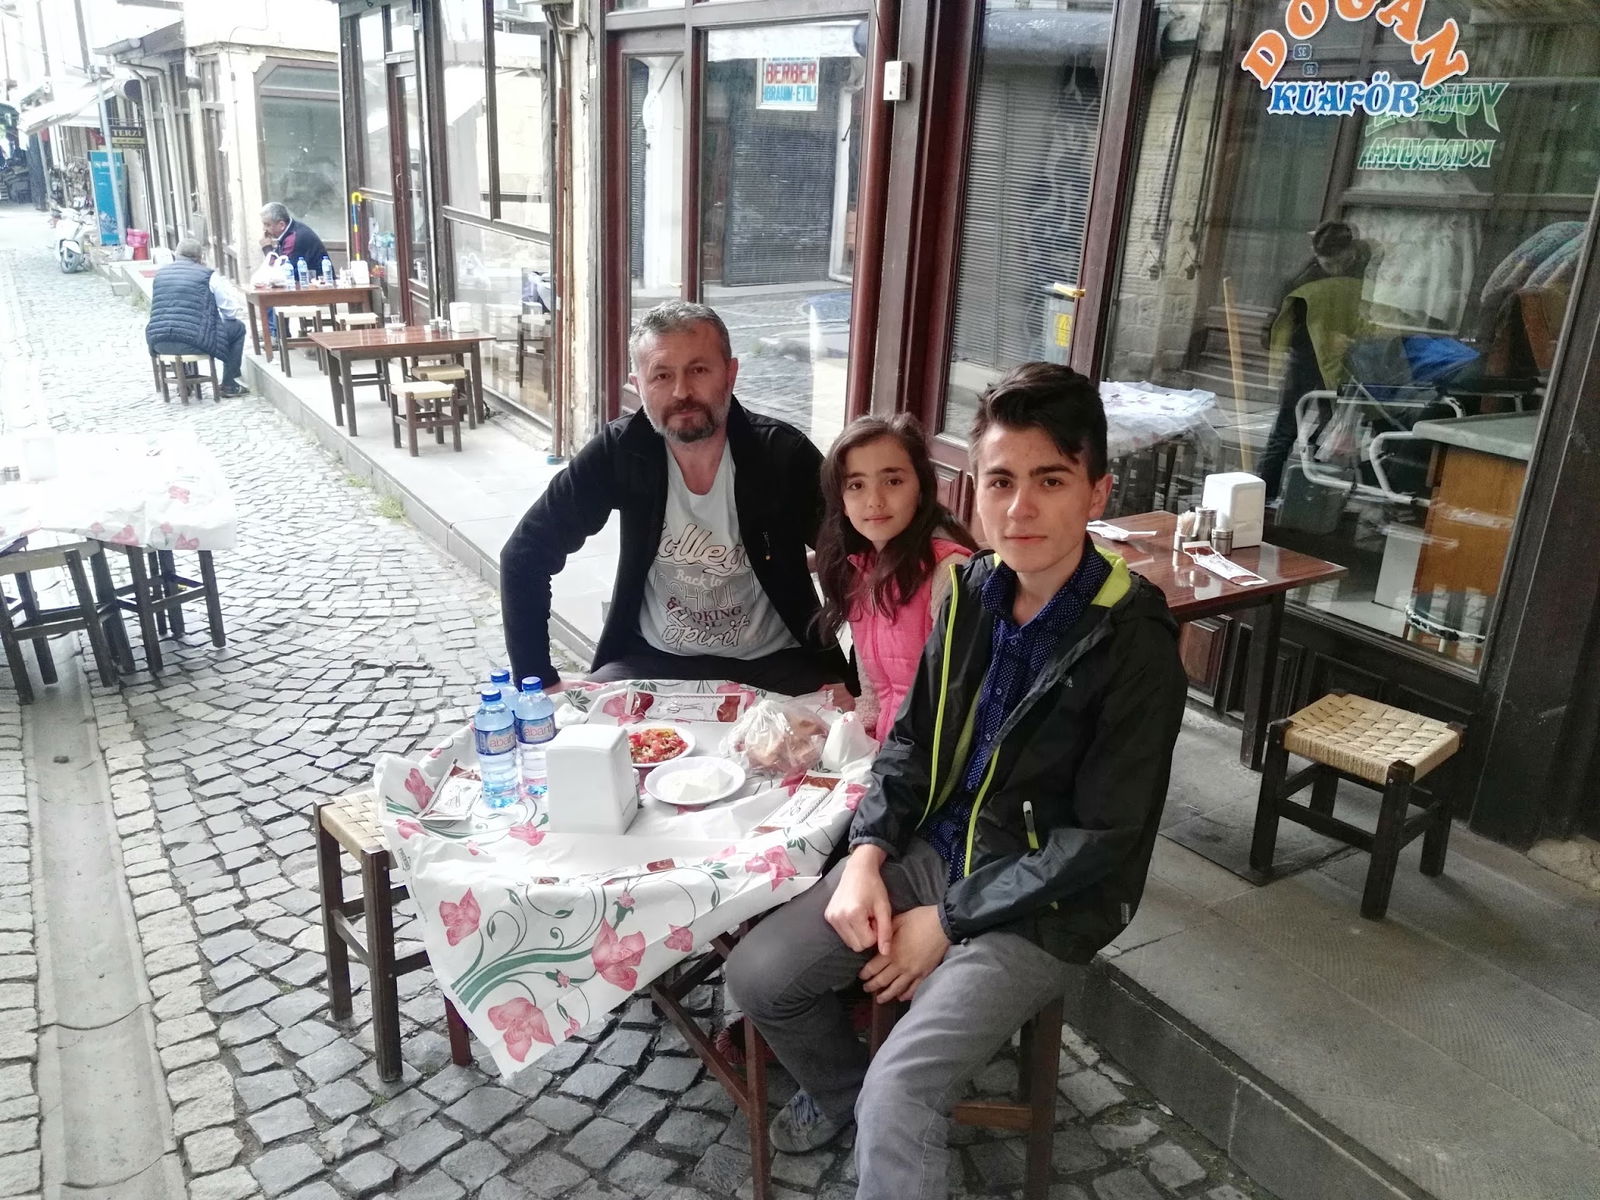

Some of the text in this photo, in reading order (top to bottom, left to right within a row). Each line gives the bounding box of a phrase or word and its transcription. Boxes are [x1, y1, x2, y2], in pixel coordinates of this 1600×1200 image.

[765, 61, 817, 84] BERBER
[1267, 71, 1420, 117] KUAFÖR
[674, 569, 707, 589] Back
